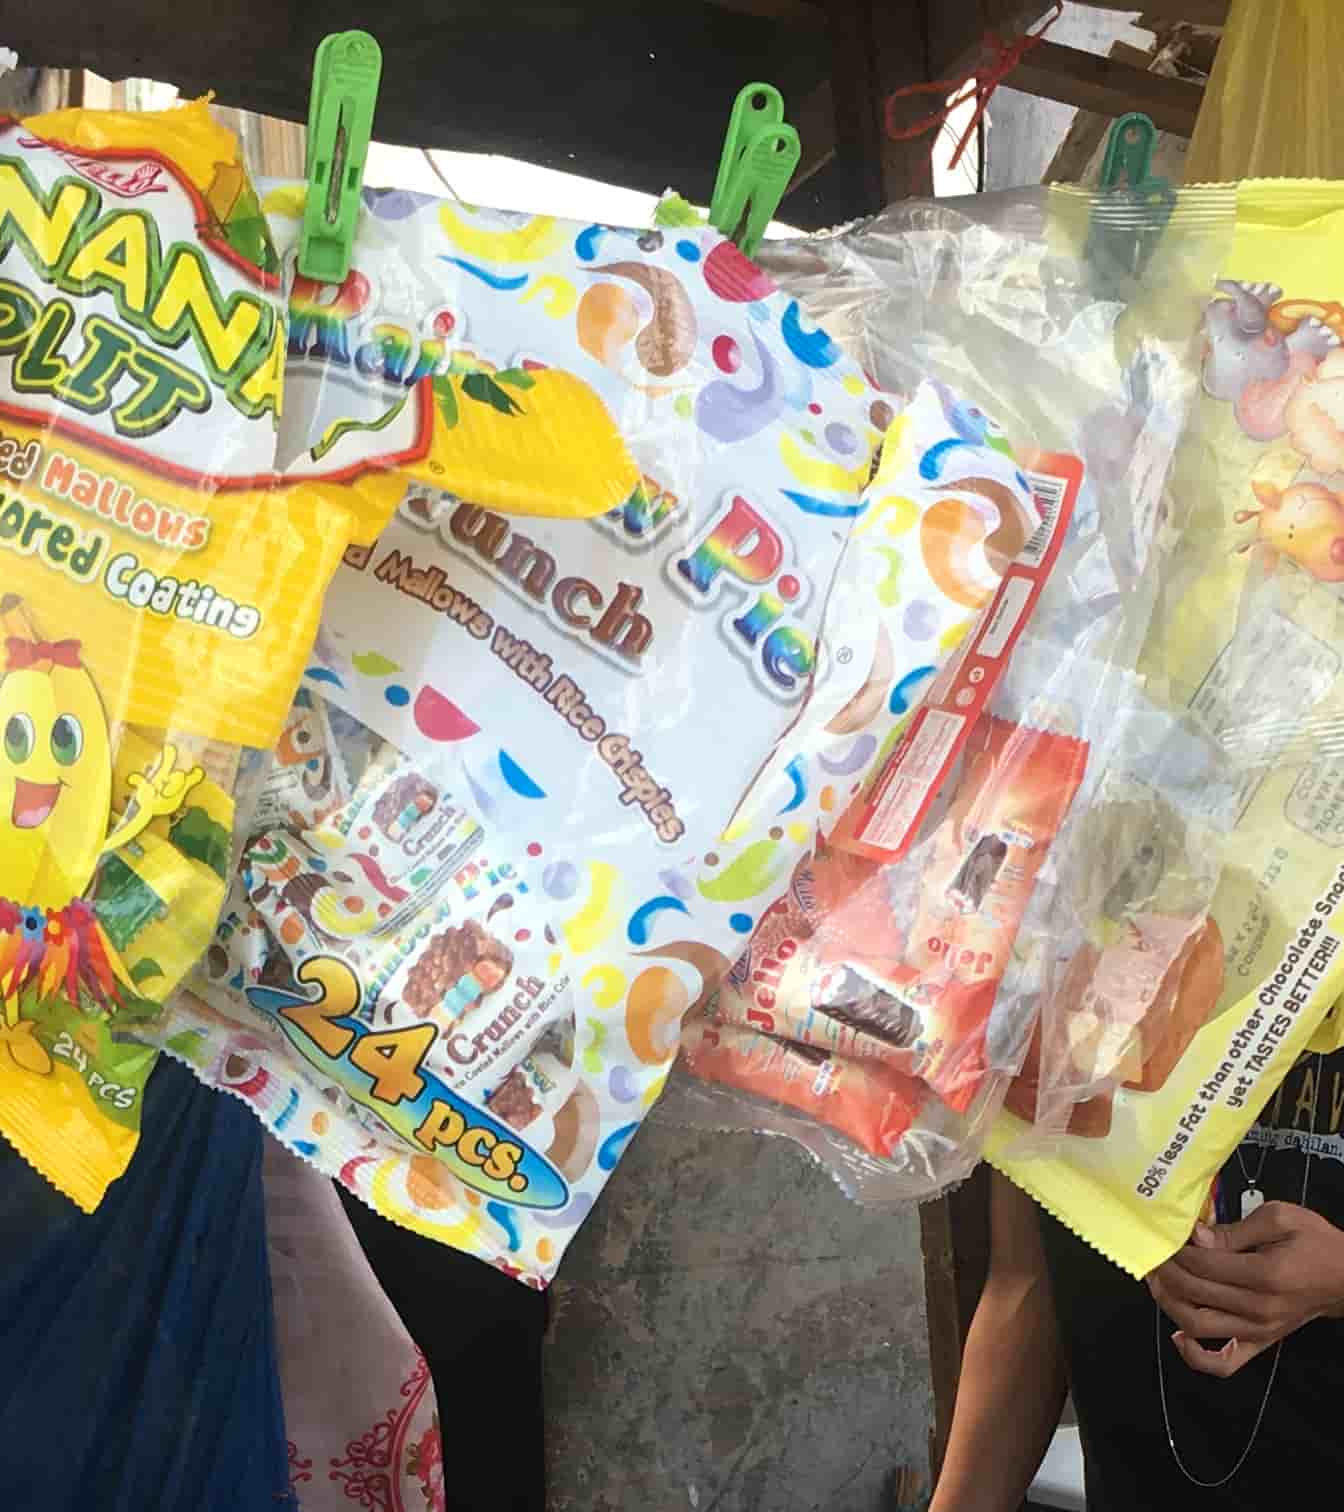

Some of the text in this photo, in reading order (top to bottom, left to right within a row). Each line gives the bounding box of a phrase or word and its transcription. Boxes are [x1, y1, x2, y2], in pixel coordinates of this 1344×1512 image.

[43, 455, 211, 548] Mallows
[106, 554, 260, 636] Coating
[409, 495, 654, 659] unch
[374, 551, 494, 640] Mallows
[491, 625, 553, 692] with
[544, 675, 606, 742] Rice
[447, 976, 546, 1065] Crunch
[747, 938, 798, 1033] Jello
[51, 1032, 90, 1075] 24
[298, 955, 529, 1193] 24 pcs.
[1136, 1167, 1168, 1199] 50%
[1158, 1134, 1190, 1169] less
[1179, 1102, 1208, 1139] Fat
[1199, 1057, 1235, 1106] than
[1229, 1010, 1265, 1060] other
[1259, 917, 1323, 1006] Chocolate
[1227, 1078, 1256, 1110] yet
[1245, 1013, 1293, 1081] TASTES
